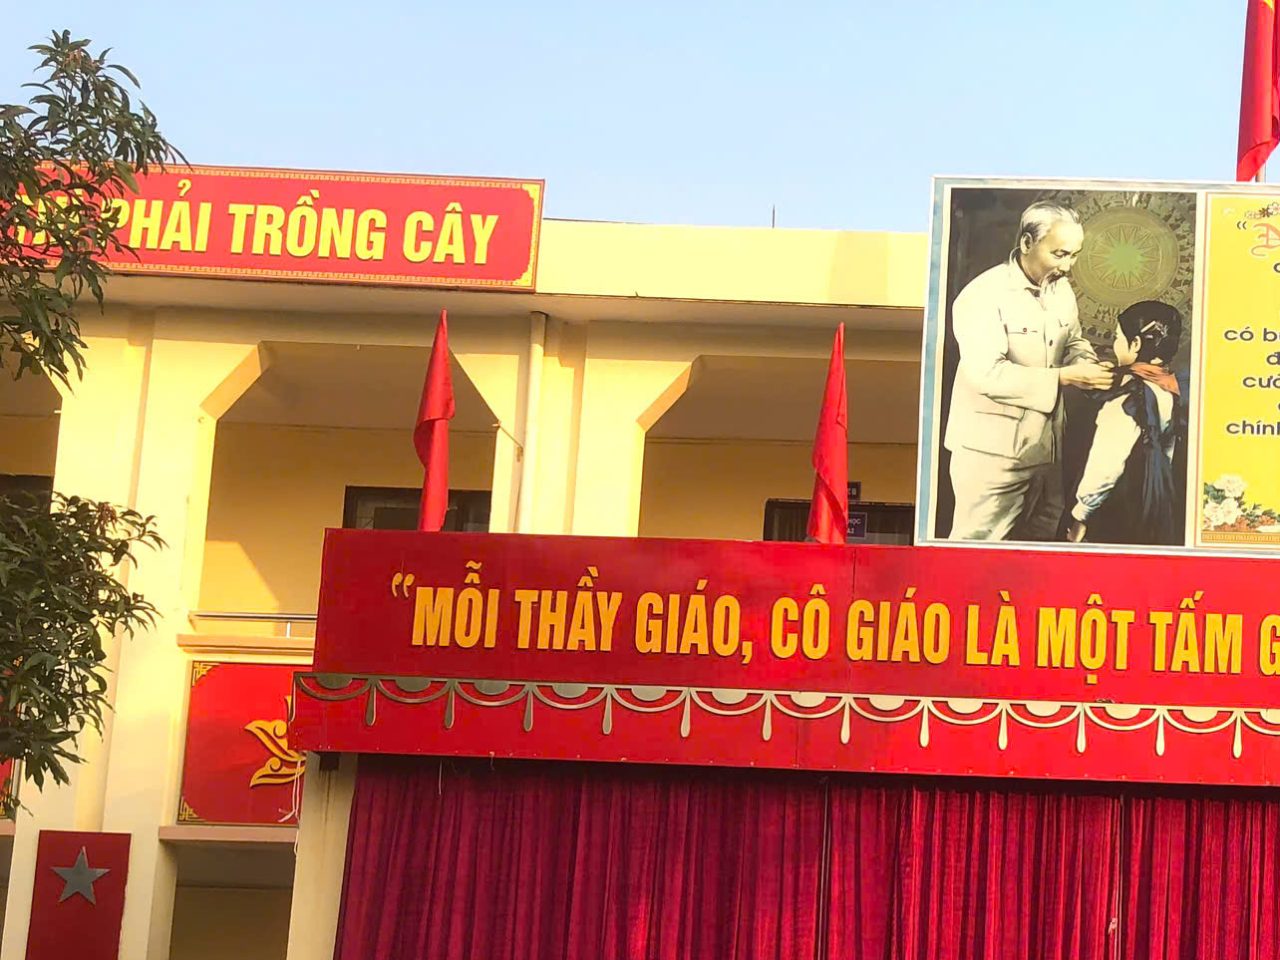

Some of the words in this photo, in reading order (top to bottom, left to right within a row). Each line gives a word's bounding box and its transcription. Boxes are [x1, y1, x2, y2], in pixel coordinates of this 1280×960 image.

[101, 179, 212, 252] PHẢI
[229, 190, 387, 260] TRỒNG
[403, 203, 498, 264] CÂY
[1225, 327, 1253, 341] có
[393, 562, 498, 646] “MỖI
[516, 568, 622, 650] THẦY
[636, 581, 752, 662] GIÁO,
[772, 585, 829, 659] CÔ
[847, 588, 949, 663] GIÁO
[967, 592, 1019, 665] LÀ
[1038, 594, 1135, 684] MỘT
[1150, 592, 1242, 673] TẤM
